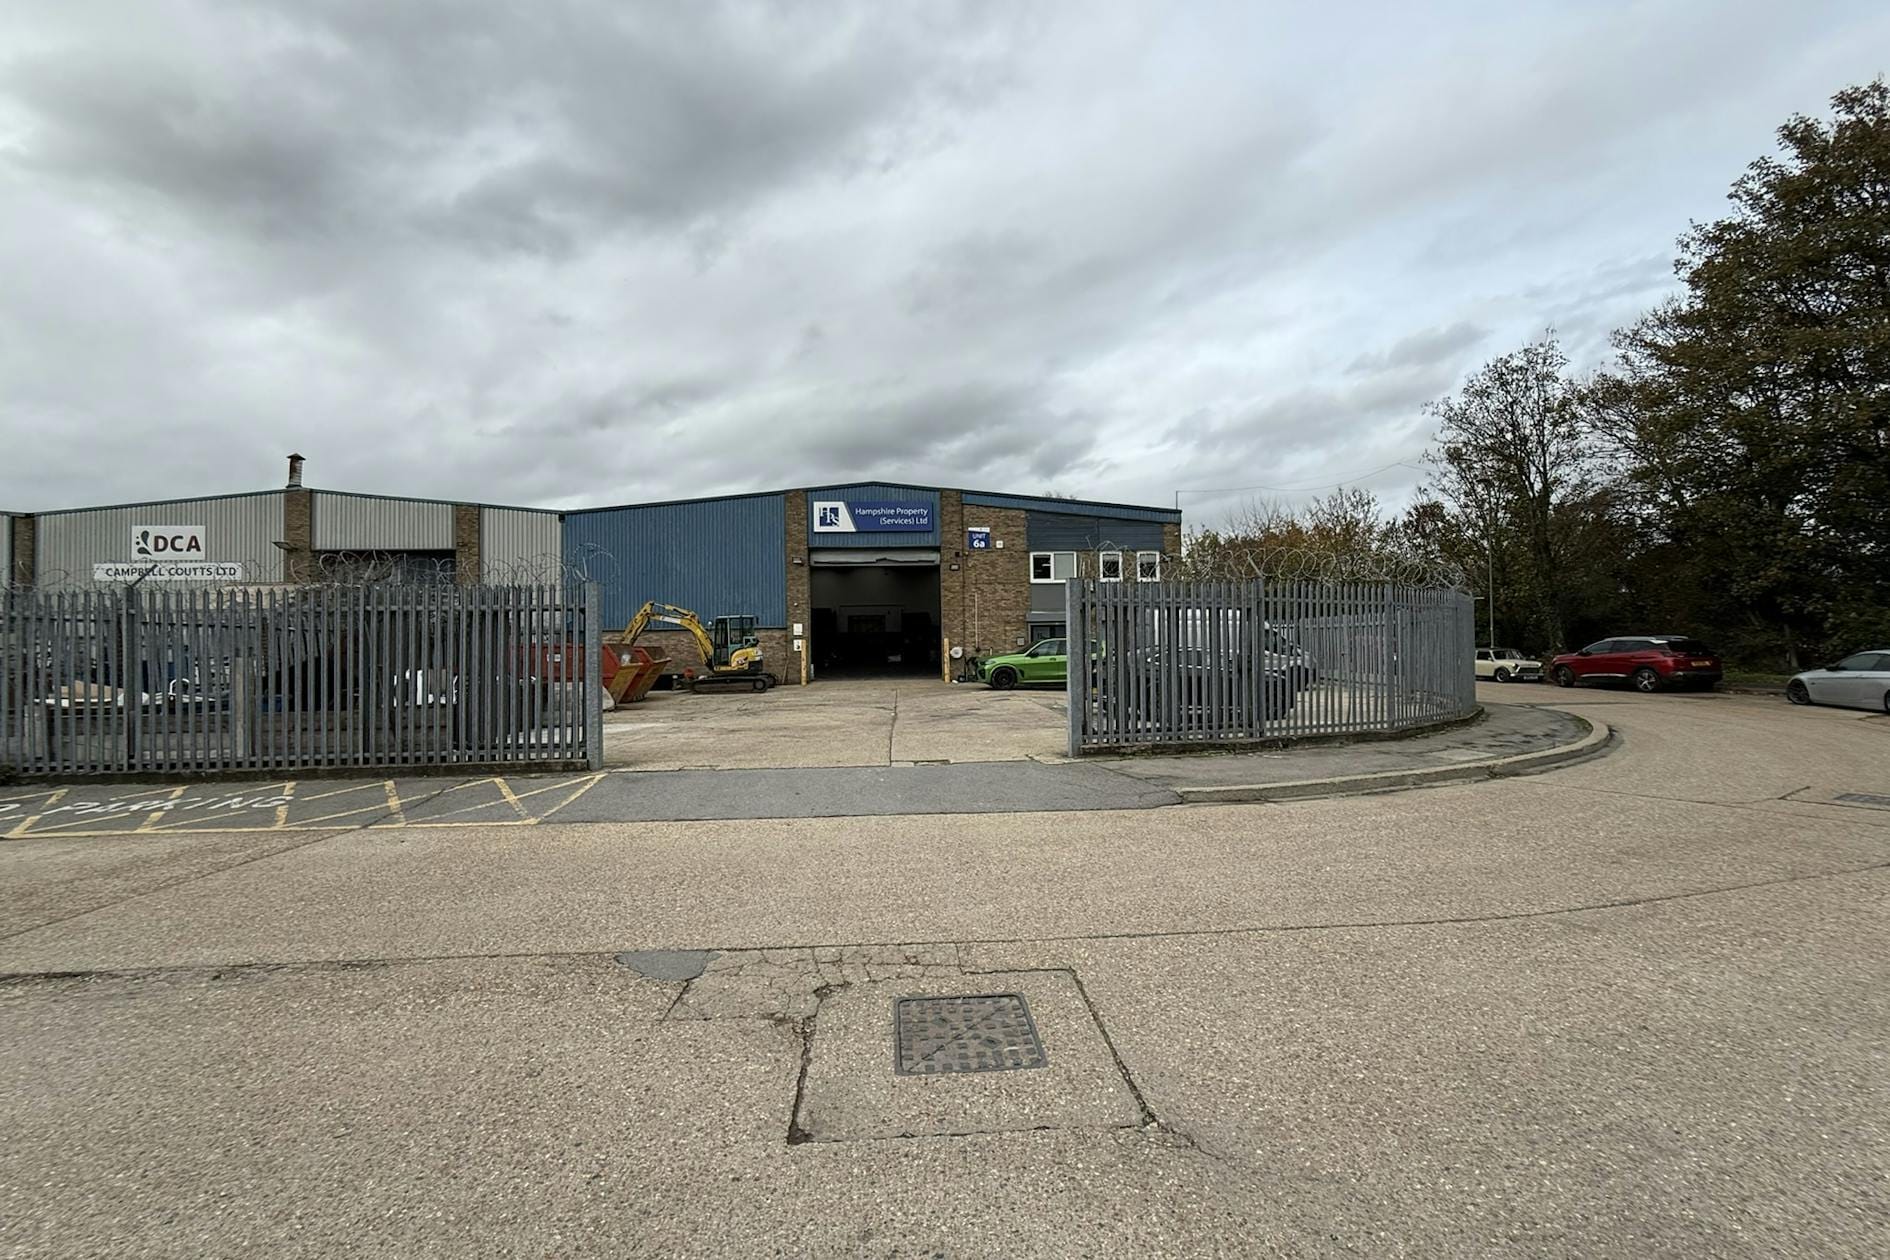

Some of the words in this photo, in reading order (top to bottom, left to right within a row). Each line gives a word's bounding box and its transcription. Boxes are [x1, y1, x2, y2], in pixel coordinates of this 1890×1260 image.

[855, 507, 895, 517] Hampshire
[896, 507, 928, 517] Property
[880, 517, 914, 525] (Services)
[915, 517, 928, 525] Ltd
[153, 535, 202, 552] DCA
[973, 539, 985, 548] 6a
[105, 567, 165, 577] CAMPBELL
[168, 567, 213, 577] COUTTS
[216, 567, 237, 576] LTD
[41, 796, 294, 816] PARKING
